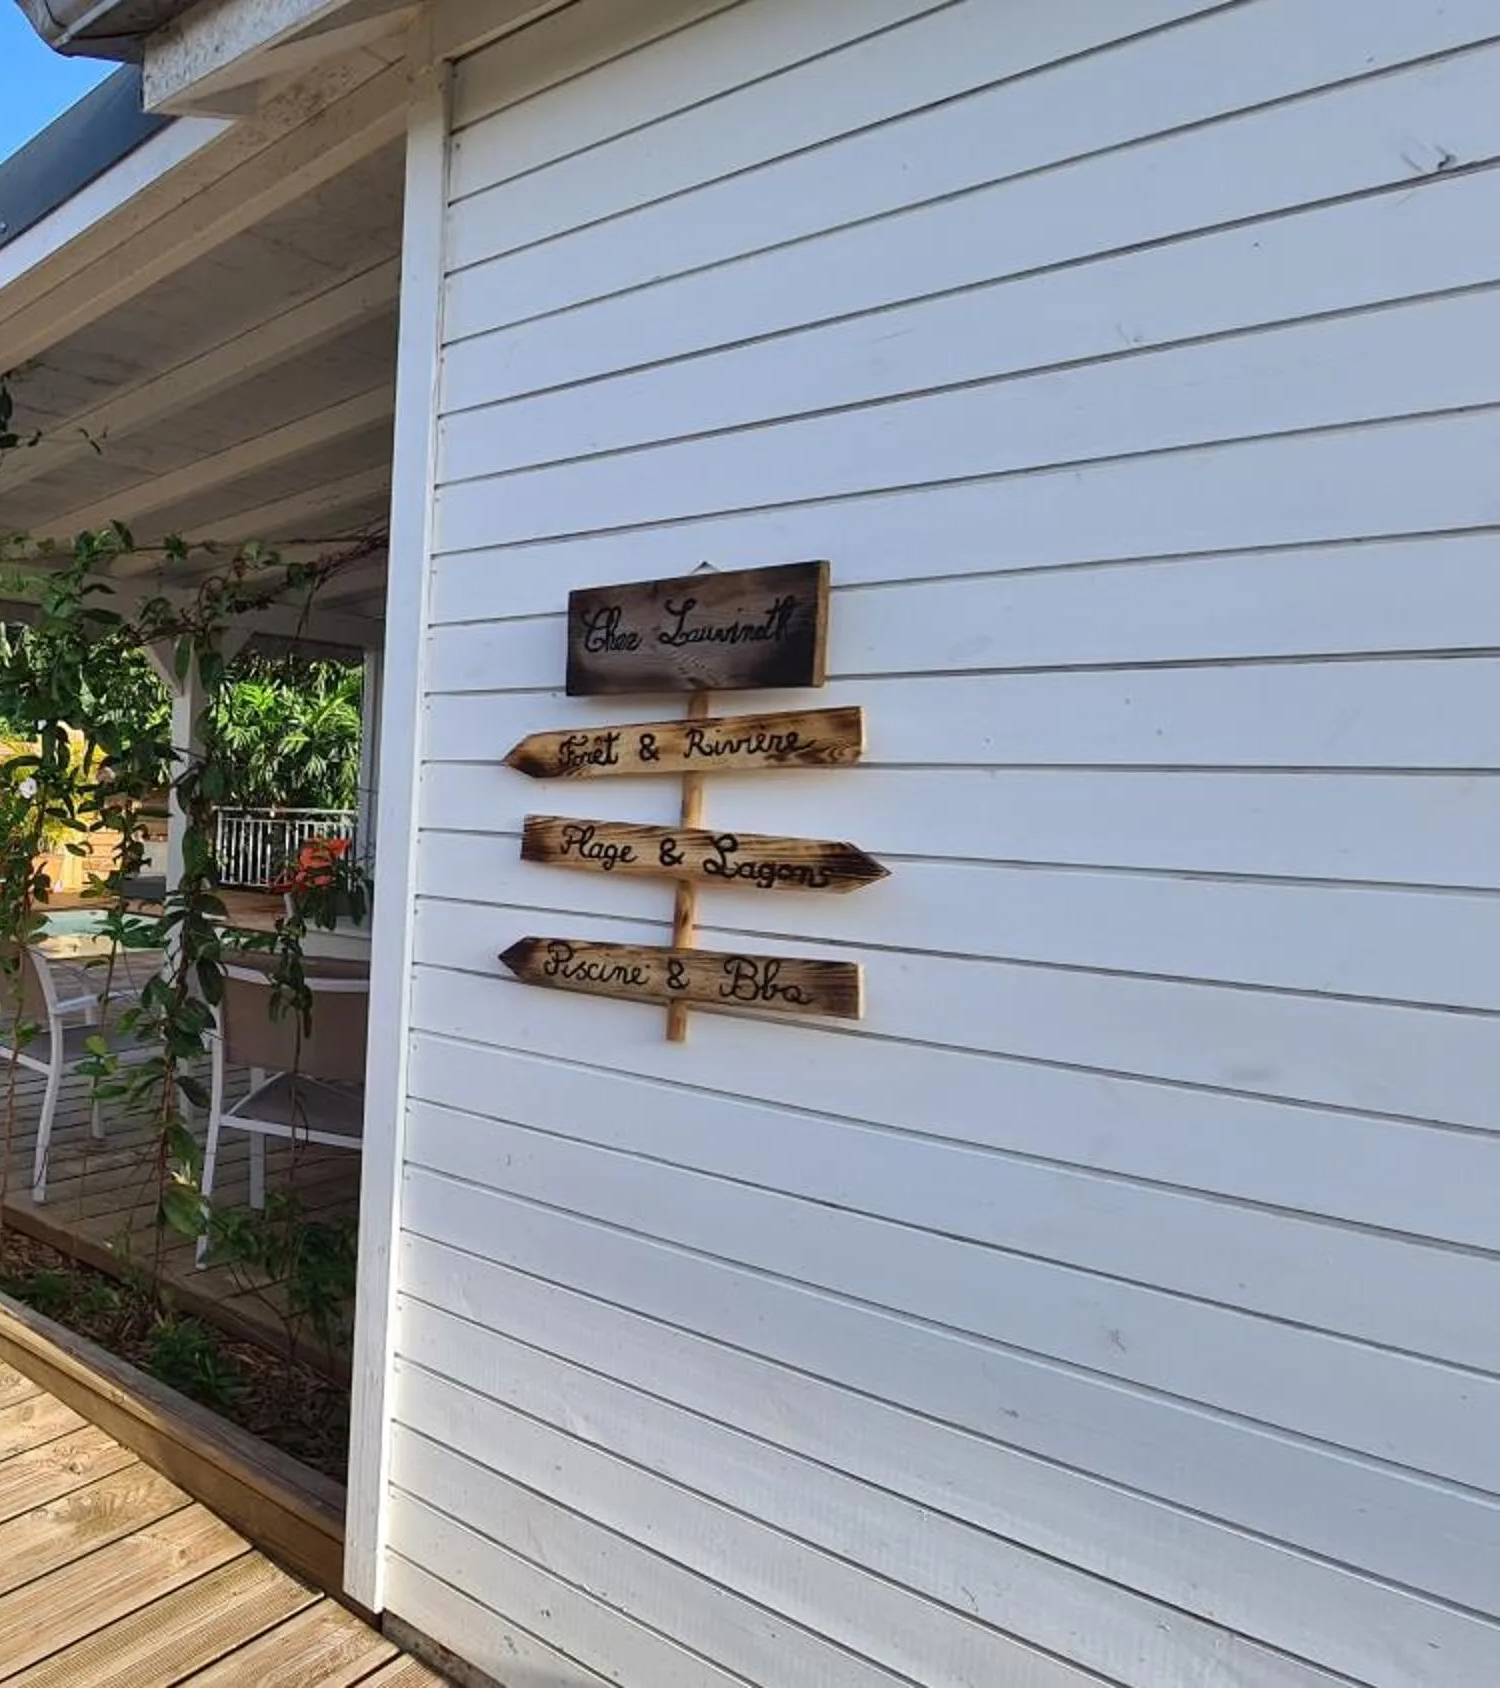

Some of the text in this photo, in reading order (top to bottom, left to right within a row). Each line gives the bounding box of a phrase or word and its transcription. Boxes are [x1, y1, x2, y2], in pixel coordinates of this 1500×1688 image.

[581, 605, 642, 652] Chez
[639, 733, 660, 761] &
[561, 825, 833, 888] Plage & Lagons
[544, 941, 650, 985] Piscine
[667, 959, 690, 990] &
